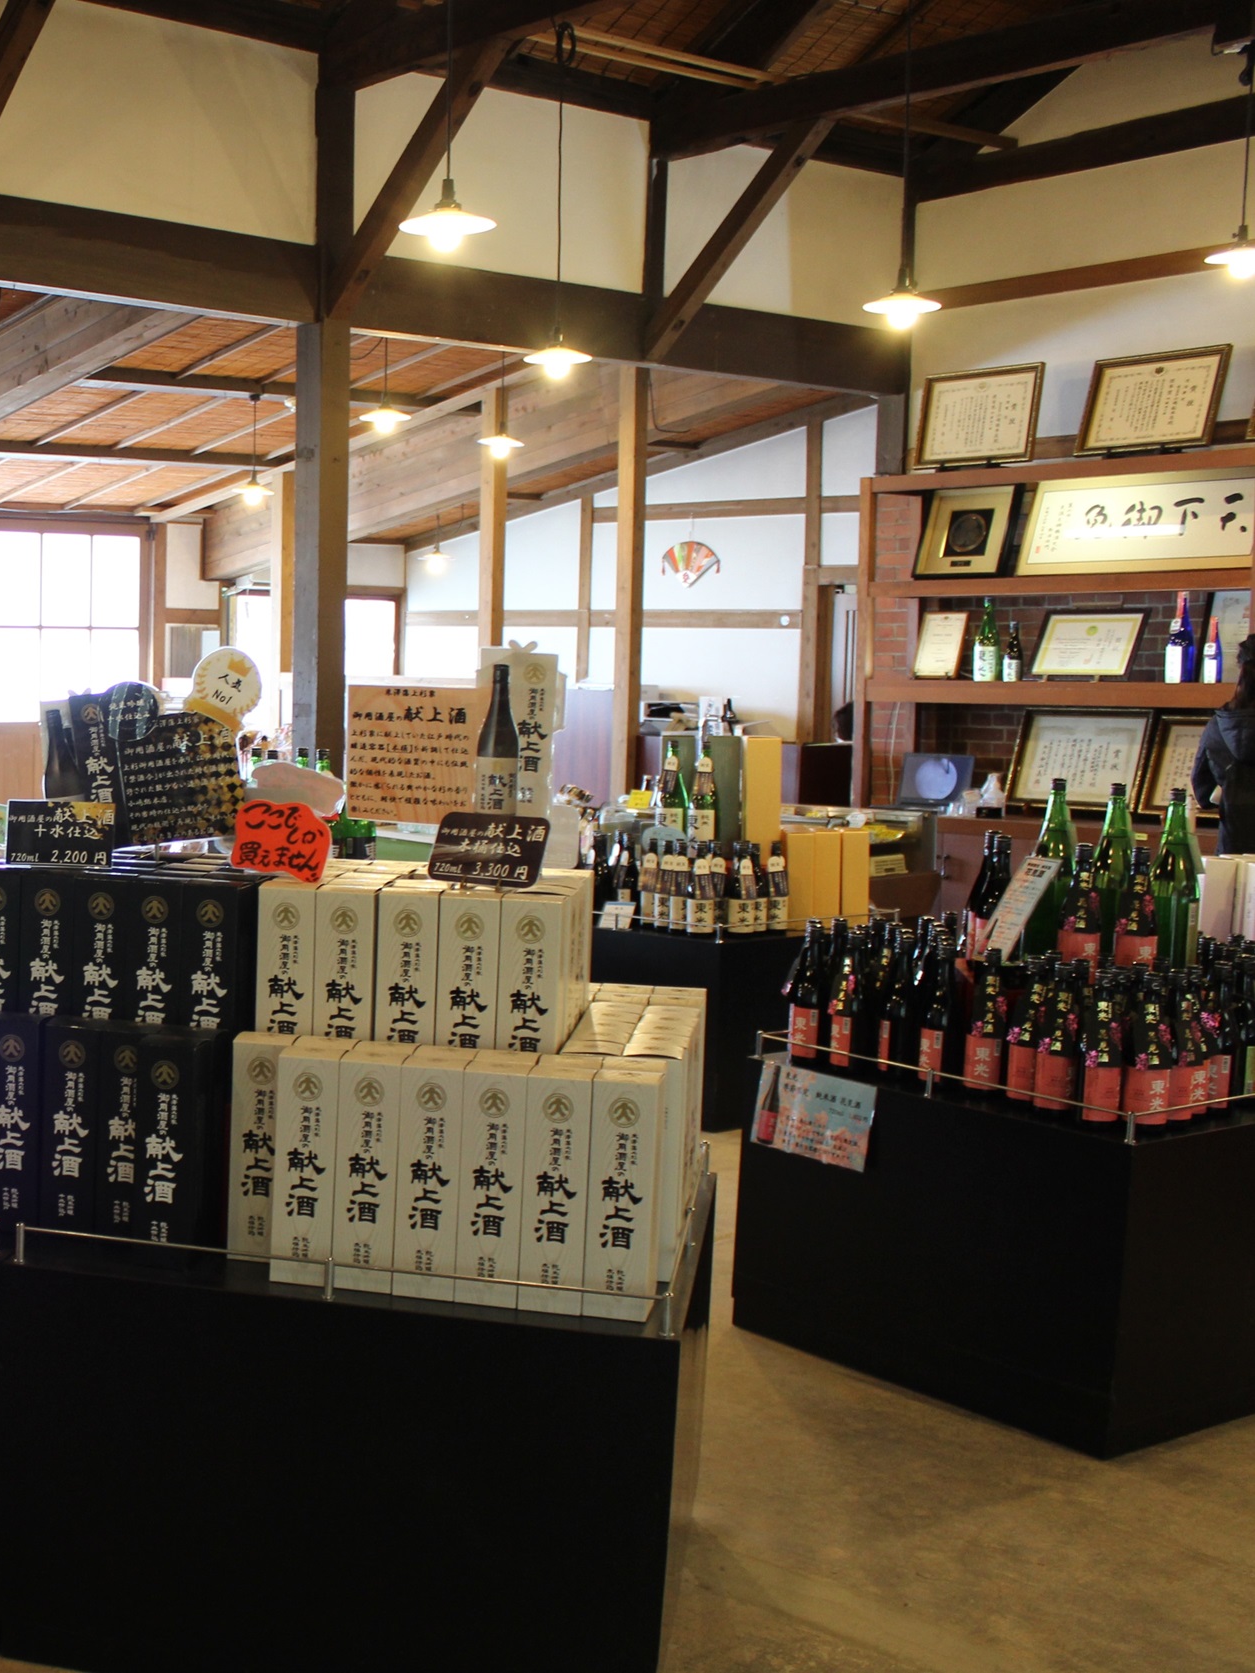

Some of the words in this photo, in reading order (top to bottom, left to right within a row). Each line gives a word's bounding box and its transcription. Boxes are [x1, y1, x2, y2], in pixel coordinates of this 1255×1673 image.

[218, 674, 244, 693] 人気
[352, 706, 466, 725] 御用酒屋の献上酒
[517, 720, 548, 773] 献上酒
[86, 756, 114, 803] 献上酒
[8, 807, 115, 826] 御用酒屋の献上酒
[34, 824, 104, 840] 十水仕込
[441, 822, 546, 842] 御用酒屋の献上酒
[10, 852, 39, 862] 720ml
[51, 850, 88, 864] 2,200
[94, 852, 107, 865] 円
[236, 840, 321, 872] 買えません
[433, 862, 463, 874] 720ml
[472, 862, 510, 878] 3,300
[514, 865, 528, 880] 円
[459, 838, 522, 857] 木桶仕込
[29, 957, 64, 1016] 献上酒
[82, 961, 118, 1020] 献上酒
[136, 966, 172, 1024] 献上酒
[190, 970, 228, 1030] 献上酒
[266, 974, 305, 1034] 献上酒
[325, 979, 363, 1038] 献上酒
[386, 982, 426, 1044] 献上酒
[448, 986, 488, 1050] 献上酒
[508, 989, 548, 1052] 献上酒
[974, 1047, 991, 1077] 東光
[1150, 1080, 1166, 1111] 東光
[52, 1110, 90, 1178] 献上酒
[107, 1116, 136, 1184] 献上酒
[144, 1134, 184, 1204] 献上酒
[241, 1130, 276, 1198] 献上酒
[285, 1148, 326, 1220] 献上酒
[346, 1153, 388, 1225] 献上酒
[409, 1160, 450, 1231] 献上酒
[470, 1166, 514, 1238] 献上酒
[534, 1171, 577, 1244] 献上酒
[599, 1176, 644, 1250] 献上酒
